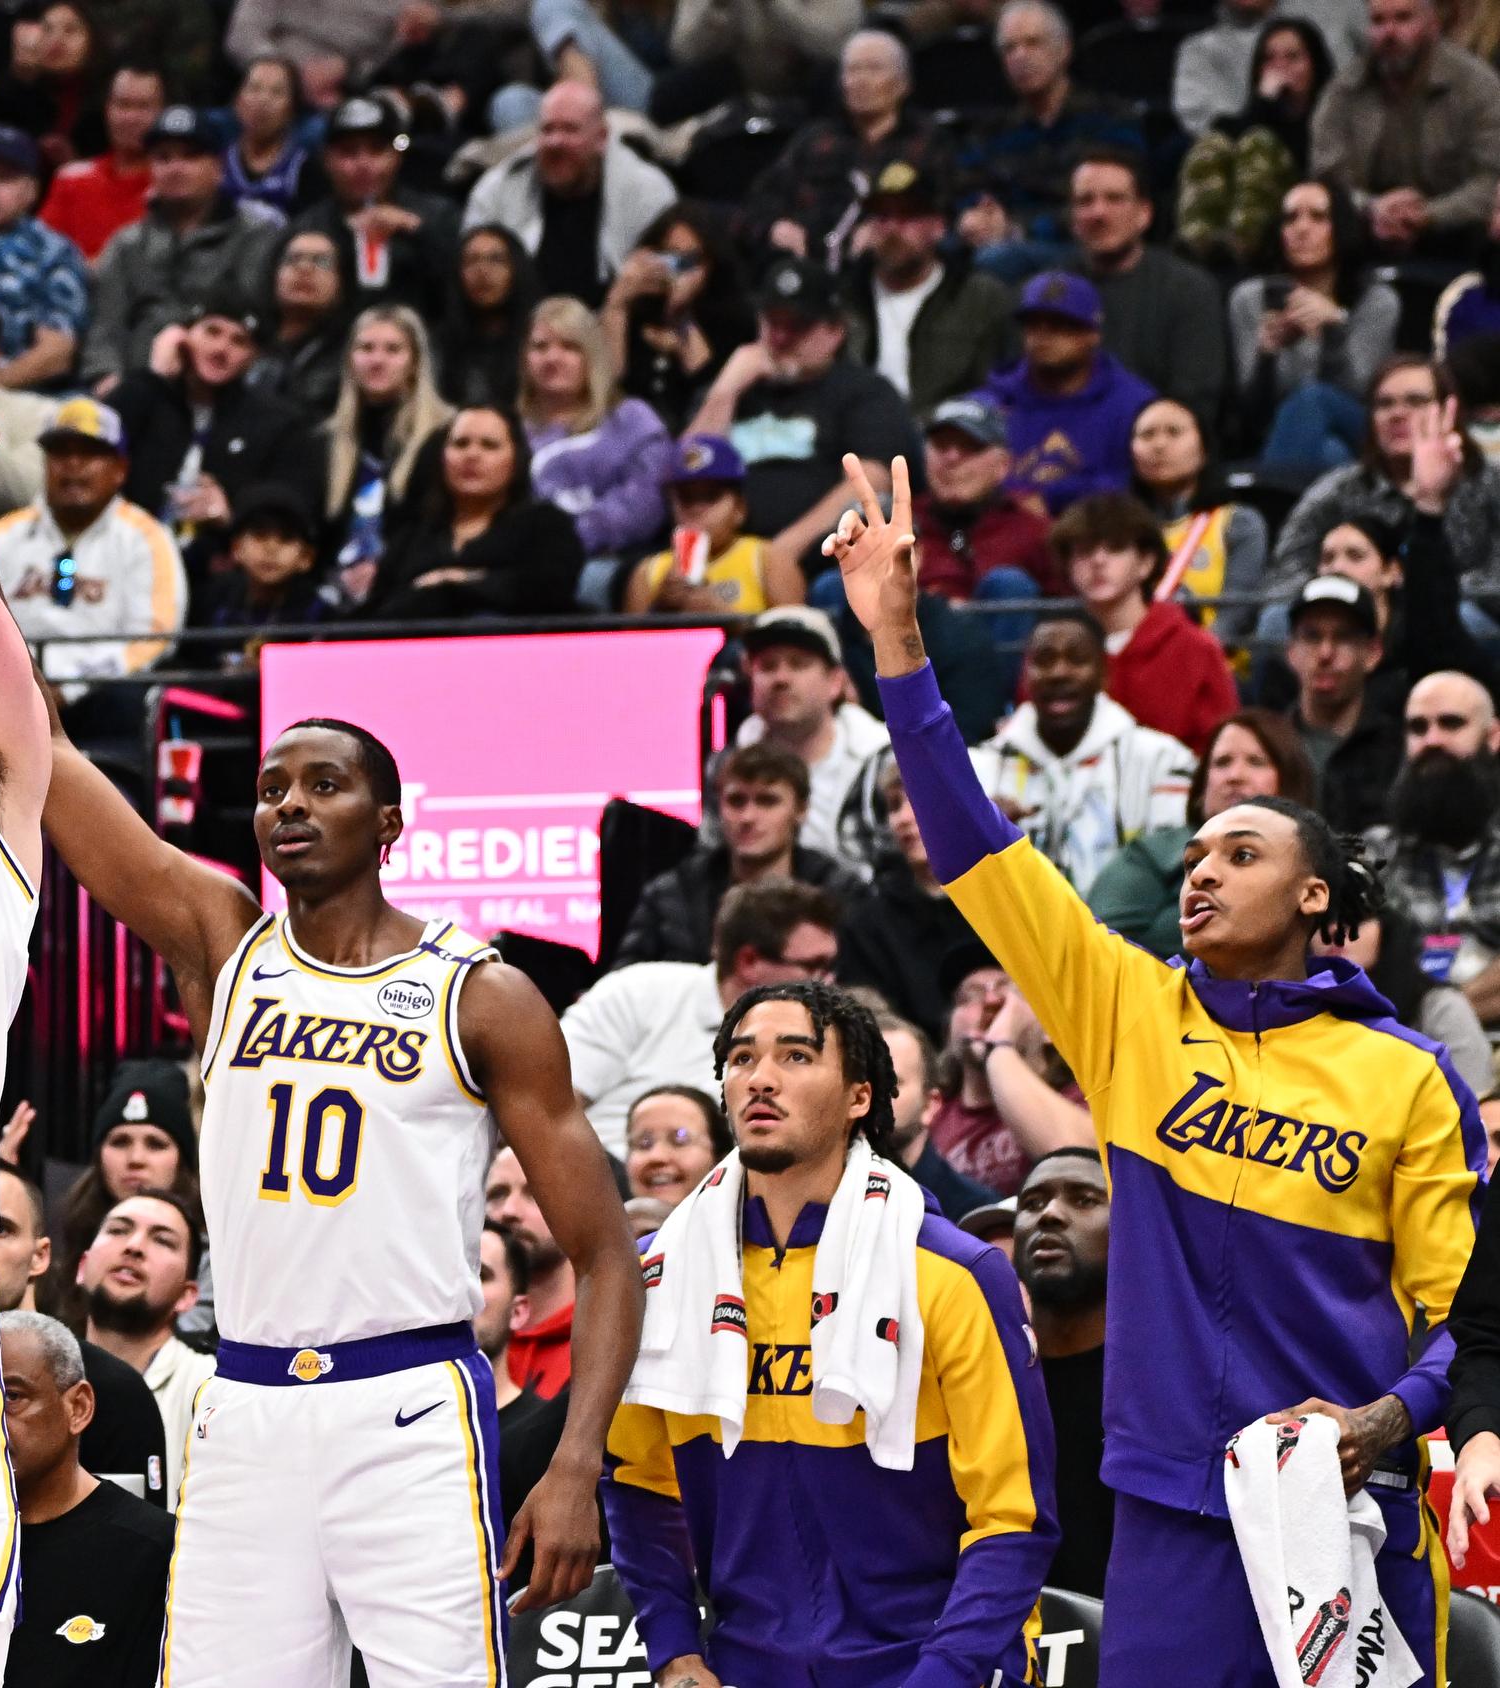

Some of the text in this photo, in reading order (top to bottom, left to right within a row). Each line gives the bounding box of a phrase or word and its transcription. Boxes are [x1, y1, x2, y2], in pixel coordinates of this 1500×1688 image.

[228, 996, 431, 1085] LAKERS
[383, 989, 431, 1010] bibigo
[258, 1079, 366, 1208] 10
[1155, 1070, 1369, 1194] LAKERS
[536, 1610, 649, 1670] SEA
